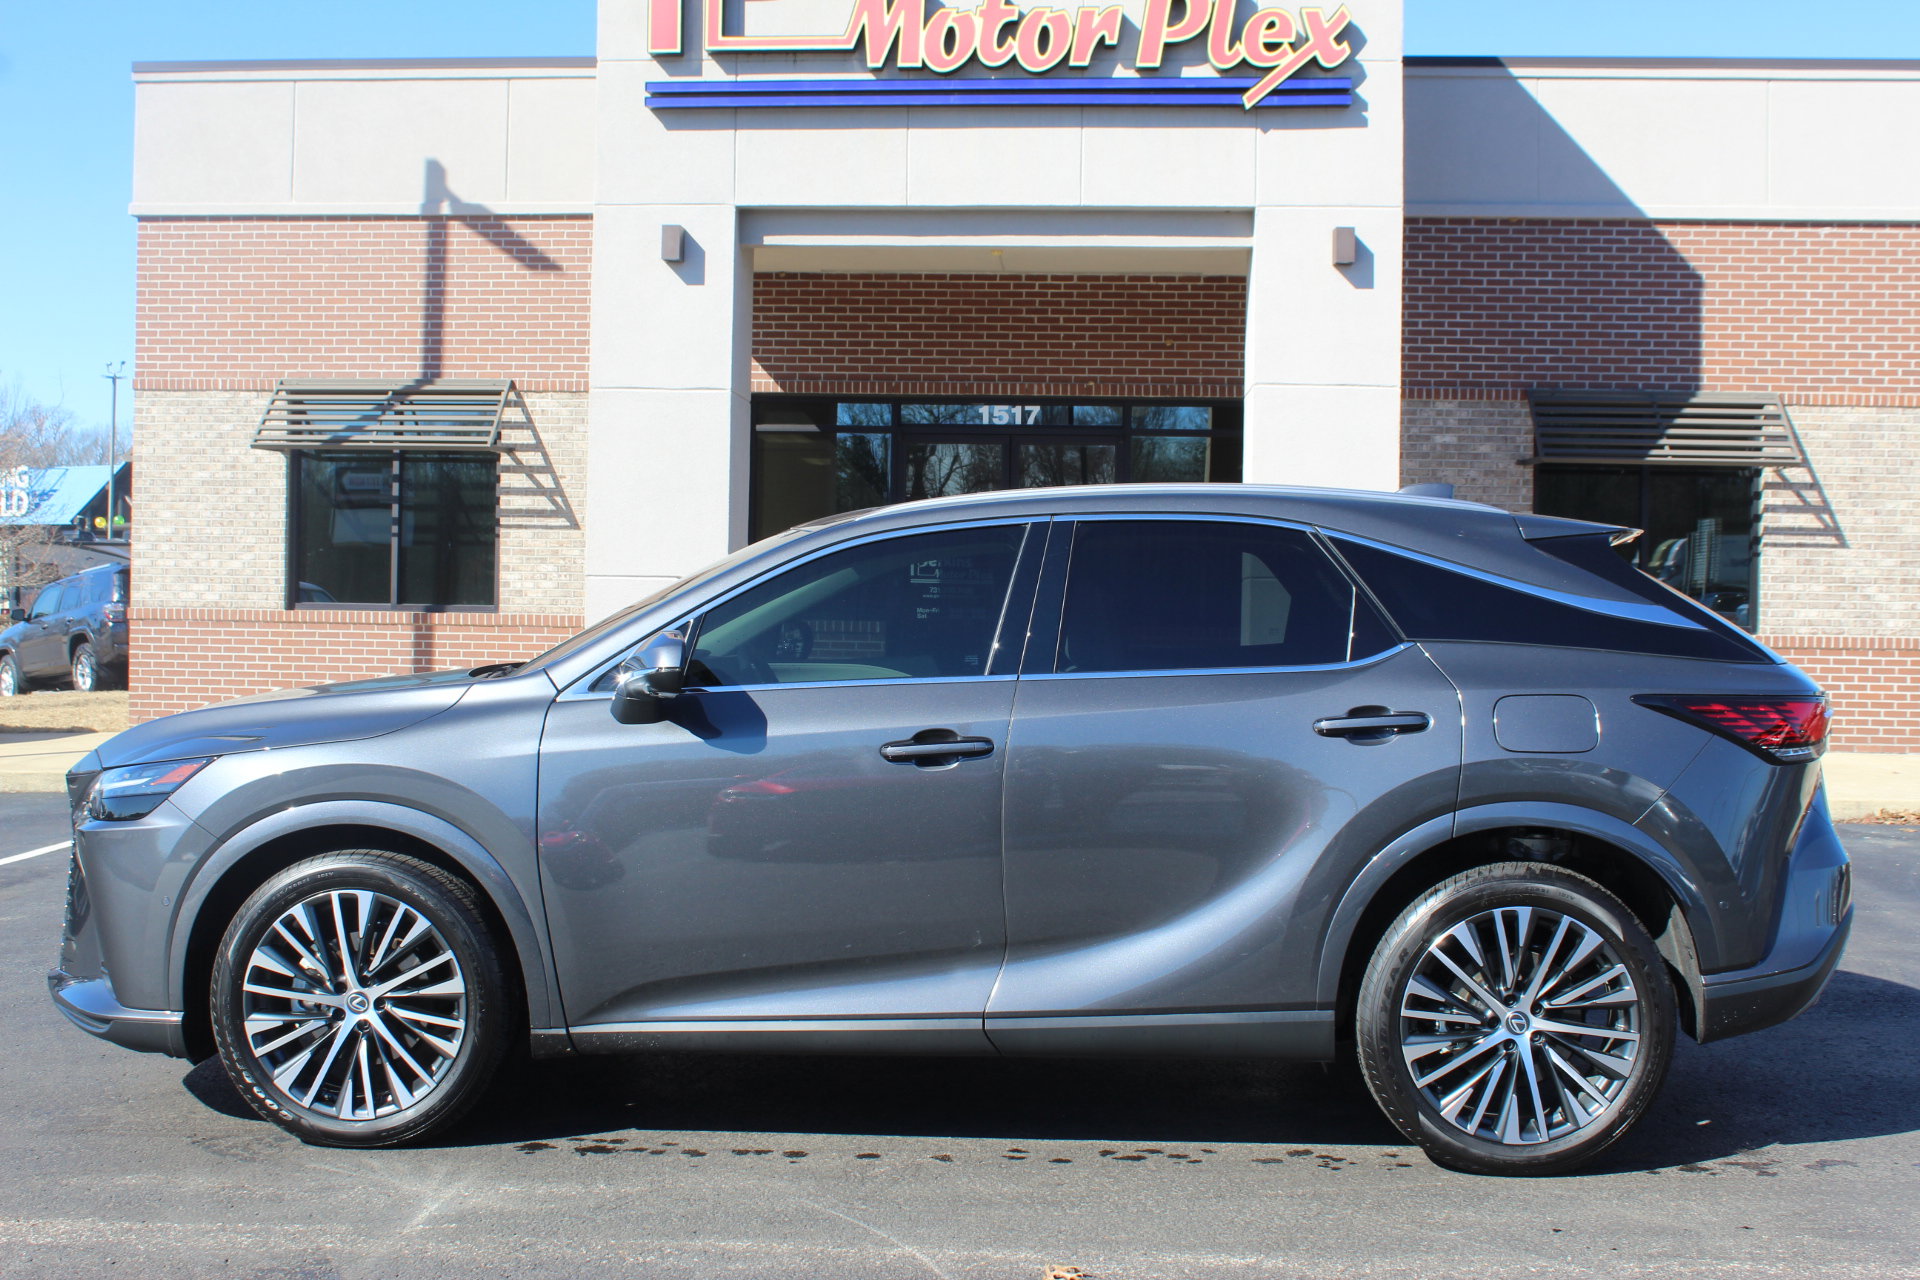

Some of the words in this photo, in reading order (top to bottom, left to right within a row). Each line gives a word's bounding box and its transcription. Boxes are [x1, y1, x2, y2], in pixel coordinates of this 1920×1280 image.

[850, 0, 1123, 72] Motor
[1135, 0, 1351, 110] Plex
[978, 404, 1041, 426] 1517
